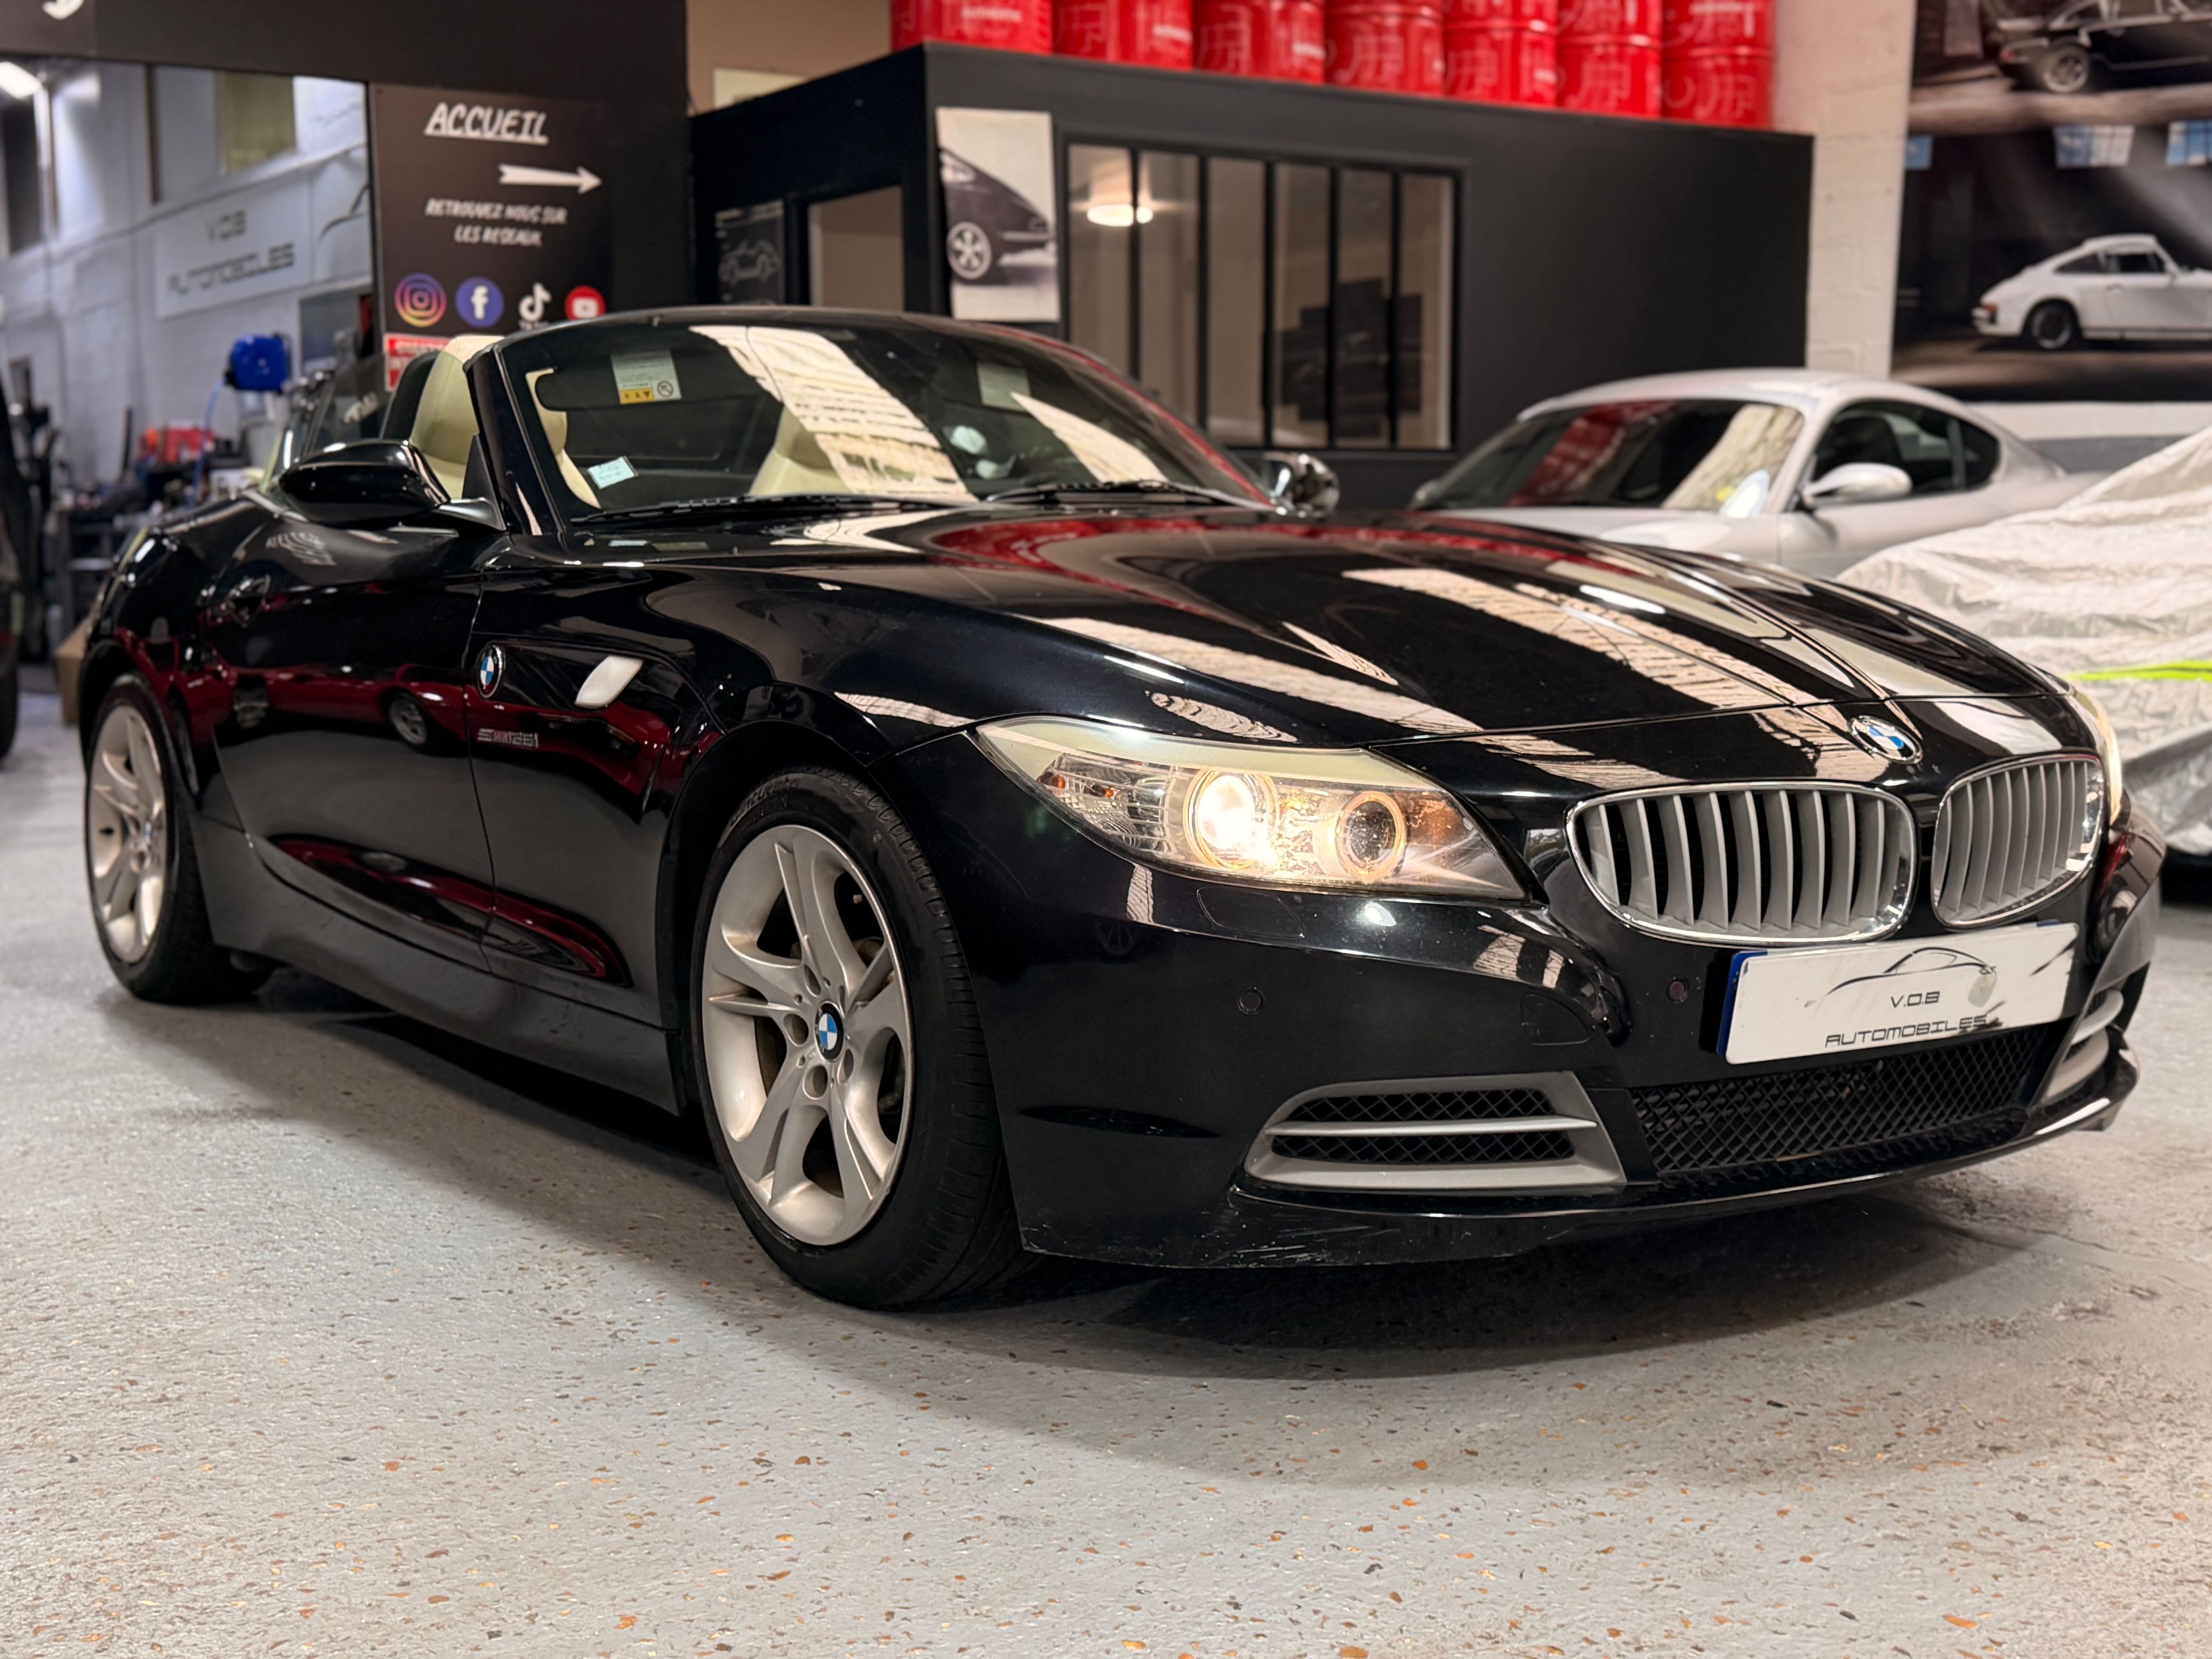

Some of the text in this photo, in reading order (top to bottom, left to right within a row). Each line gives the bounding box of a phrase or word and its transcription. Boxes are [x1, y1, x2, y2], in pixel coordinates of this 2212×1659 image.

[424, 103, 548, 144] ACCUEIL
[454, 225, 481, 244] LES
[1891, 991, 1940, 1008] V.O.B
[1825, 1014, 1987, 1048] AUTOMOBILES
